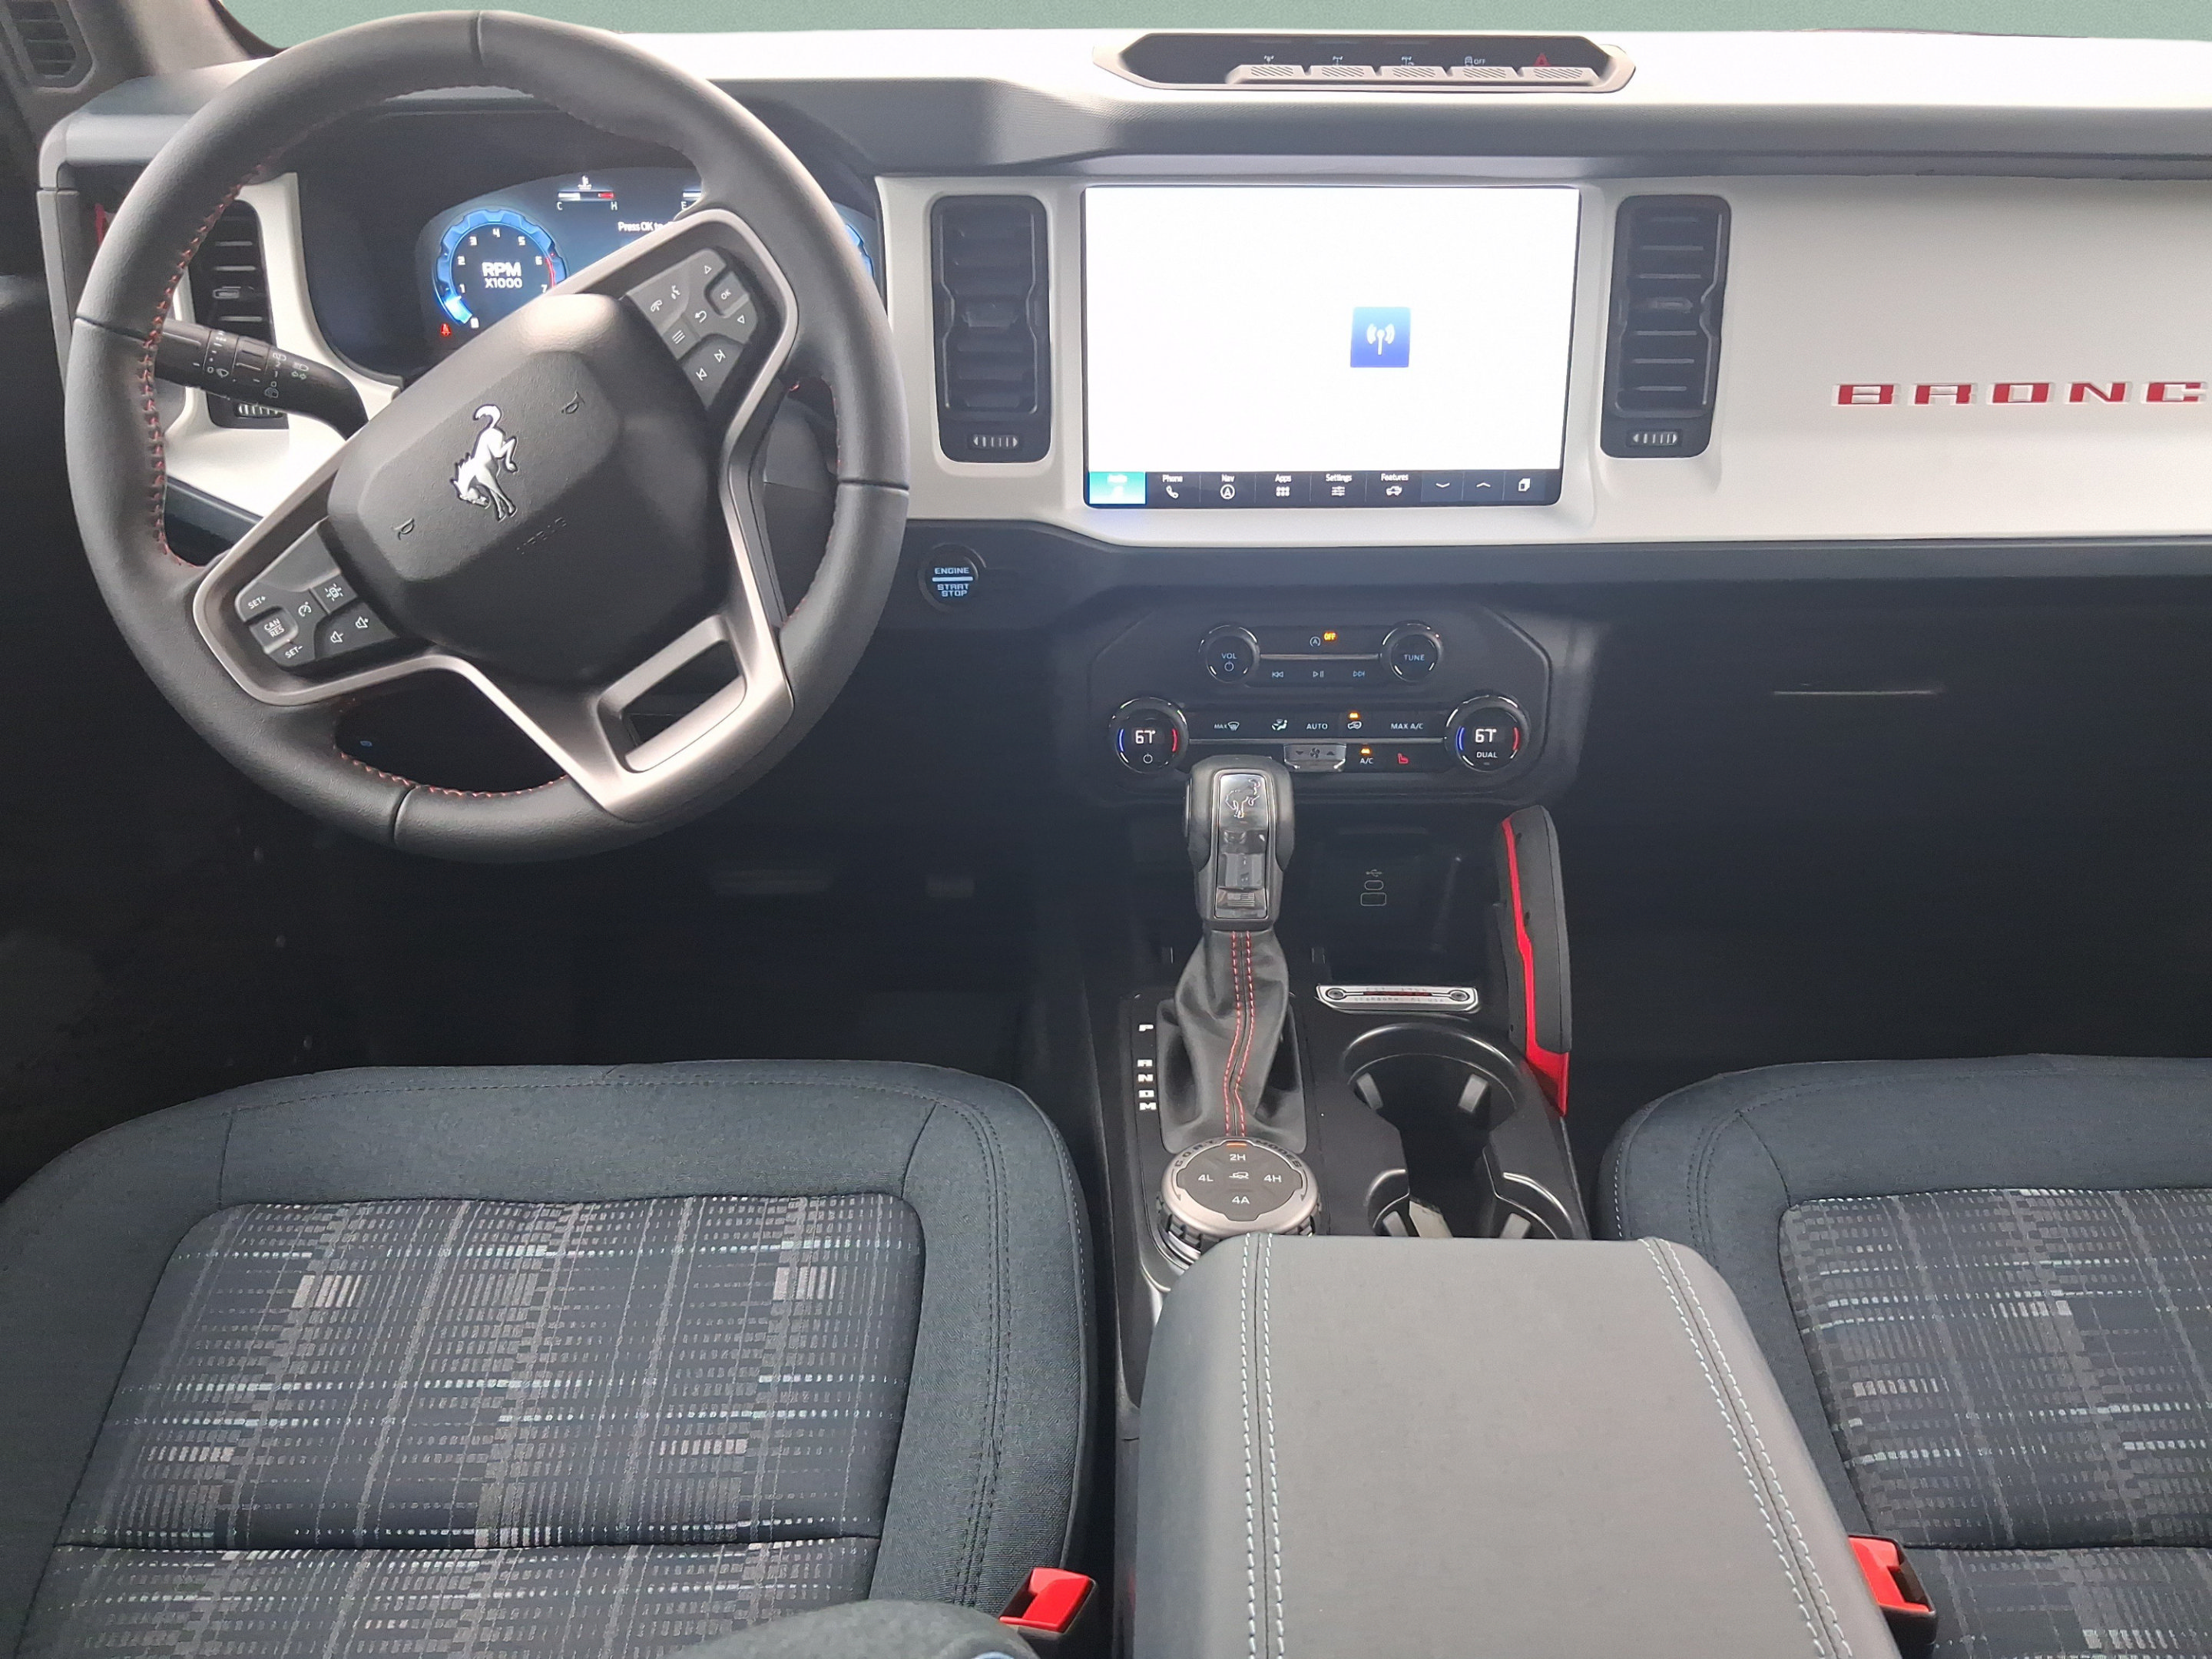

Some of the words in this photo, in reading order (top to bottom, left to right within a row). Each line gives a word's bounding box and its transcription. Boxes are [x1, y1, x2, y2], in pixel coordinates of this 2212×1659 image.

[557, 202, 563, 210] C
[611, 202, 618, 210] H
[618, 221, 641, 232] Press
[641, 221, 654, 231] OK
[492, 228, 500, 237] 4
[469, 236, 477, 246] 3
[518, 236, 526, 246] 5
[457, 256, 465, 265] 2
[535, 256, 542, 265] 6
[482, 262, 522, 276] RPM
[485, 277, 522, 288] X1000
[459, 283, 465, 293] 1
[541, 284, 548, 293] 7
[721, 289, 731, 300] OK
[1836, 382, 2202, 405] BRONC
[1162, 474, 1184, 483] Phone
[1221, 474, 1235, 482] Nav
[1274, 473, 1292, 483] Apps
[1325, 473, 1353, 483] Settings
[1381, 473, 1409, 482] Features
[263, 618, 281, 631] CAN
[269, 625, 285, 638] RES
[1323, 632, 1336, 641] OFF
[1255, 1140, 1302, 1167] MODES
[1263, 1174, 1282, 1183] 4H
[1231, 1196, 1250, 1204] 4A
